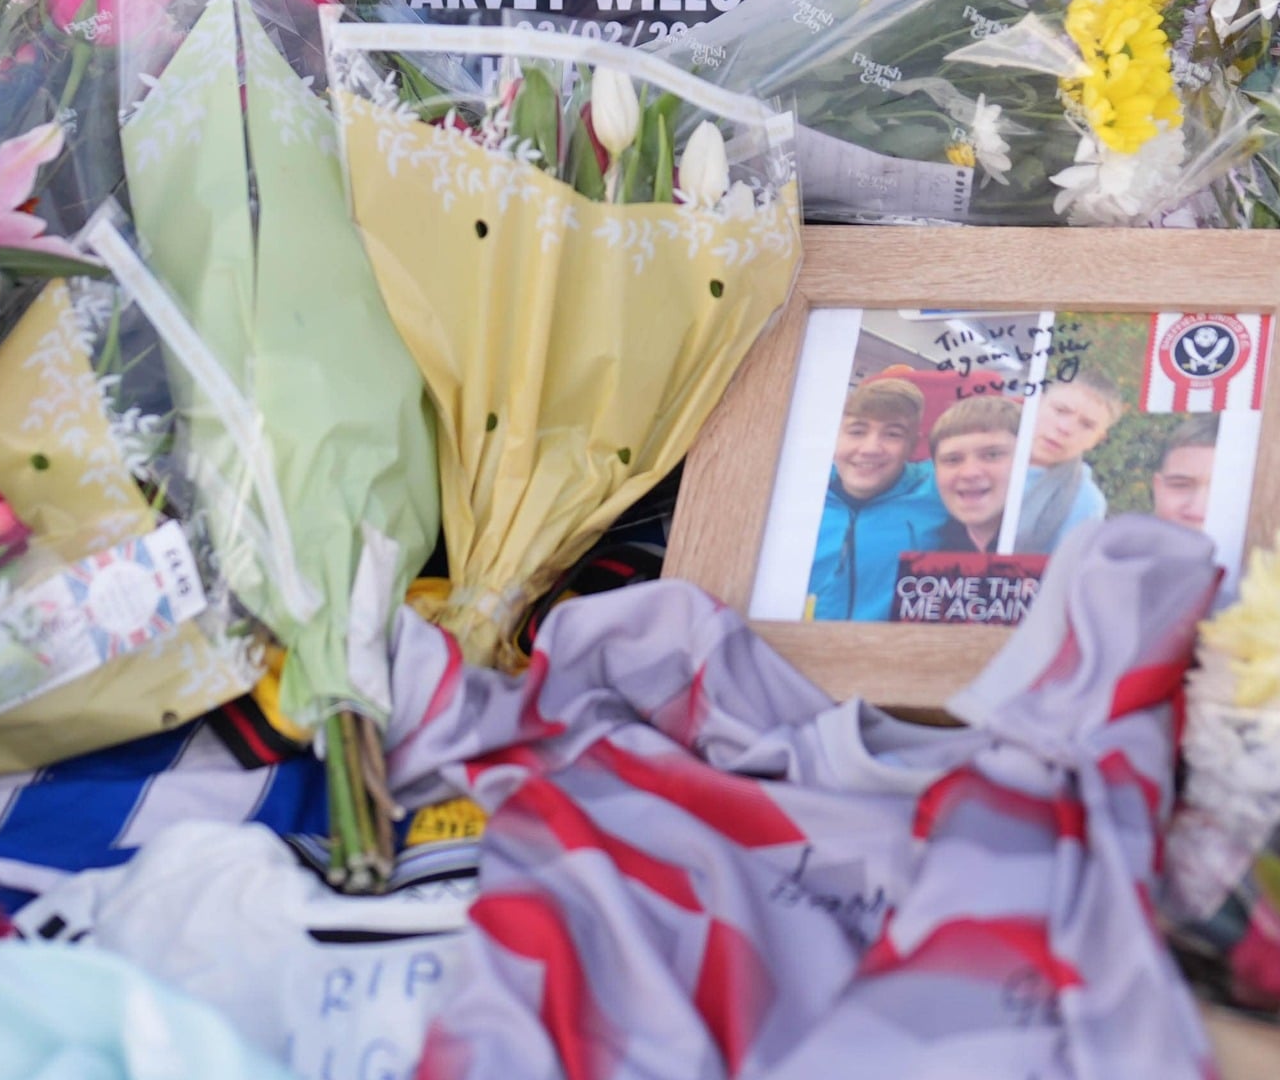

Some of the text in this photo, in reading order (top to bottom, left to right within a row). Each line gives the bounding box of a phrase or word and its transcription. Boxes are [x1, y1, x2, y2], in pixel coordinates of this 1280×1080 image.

[934, 330, 974, 352] Till
[897, 576, 983, 599] COME
[899, 599, 944, 621] ME
